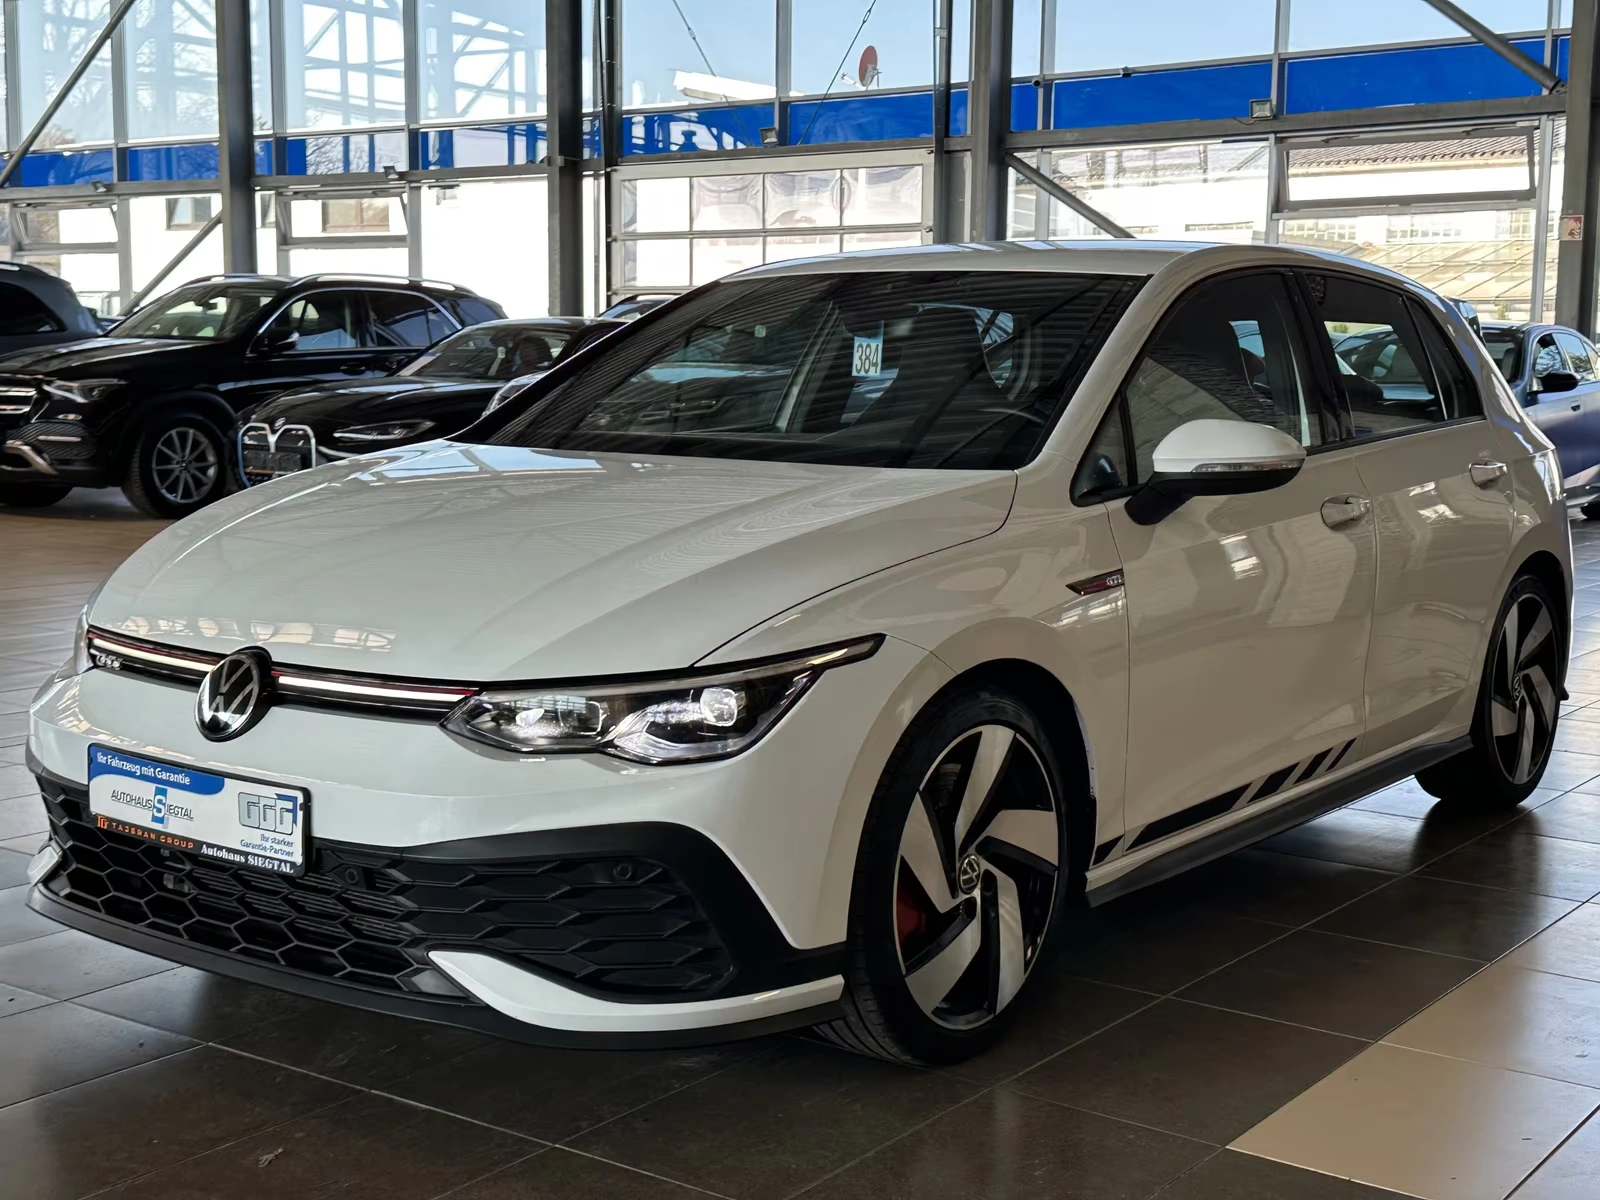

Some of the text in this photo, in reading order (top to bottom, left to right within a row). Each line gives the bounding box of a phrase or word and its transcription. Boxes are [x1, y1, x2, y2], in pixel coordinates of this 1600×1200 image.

[855, 342, 880, 375] 384
[96, 752, 191, 785] Ihr Fahrzeug mit Garantie
[110, 789, 153, 809] AUTOHAUS
[160, 835, 194, 849] GROUP
[260, 834, 294, 848] Ihr starker
[200, 844, 295, 874] Autohaus SIEGTAL
